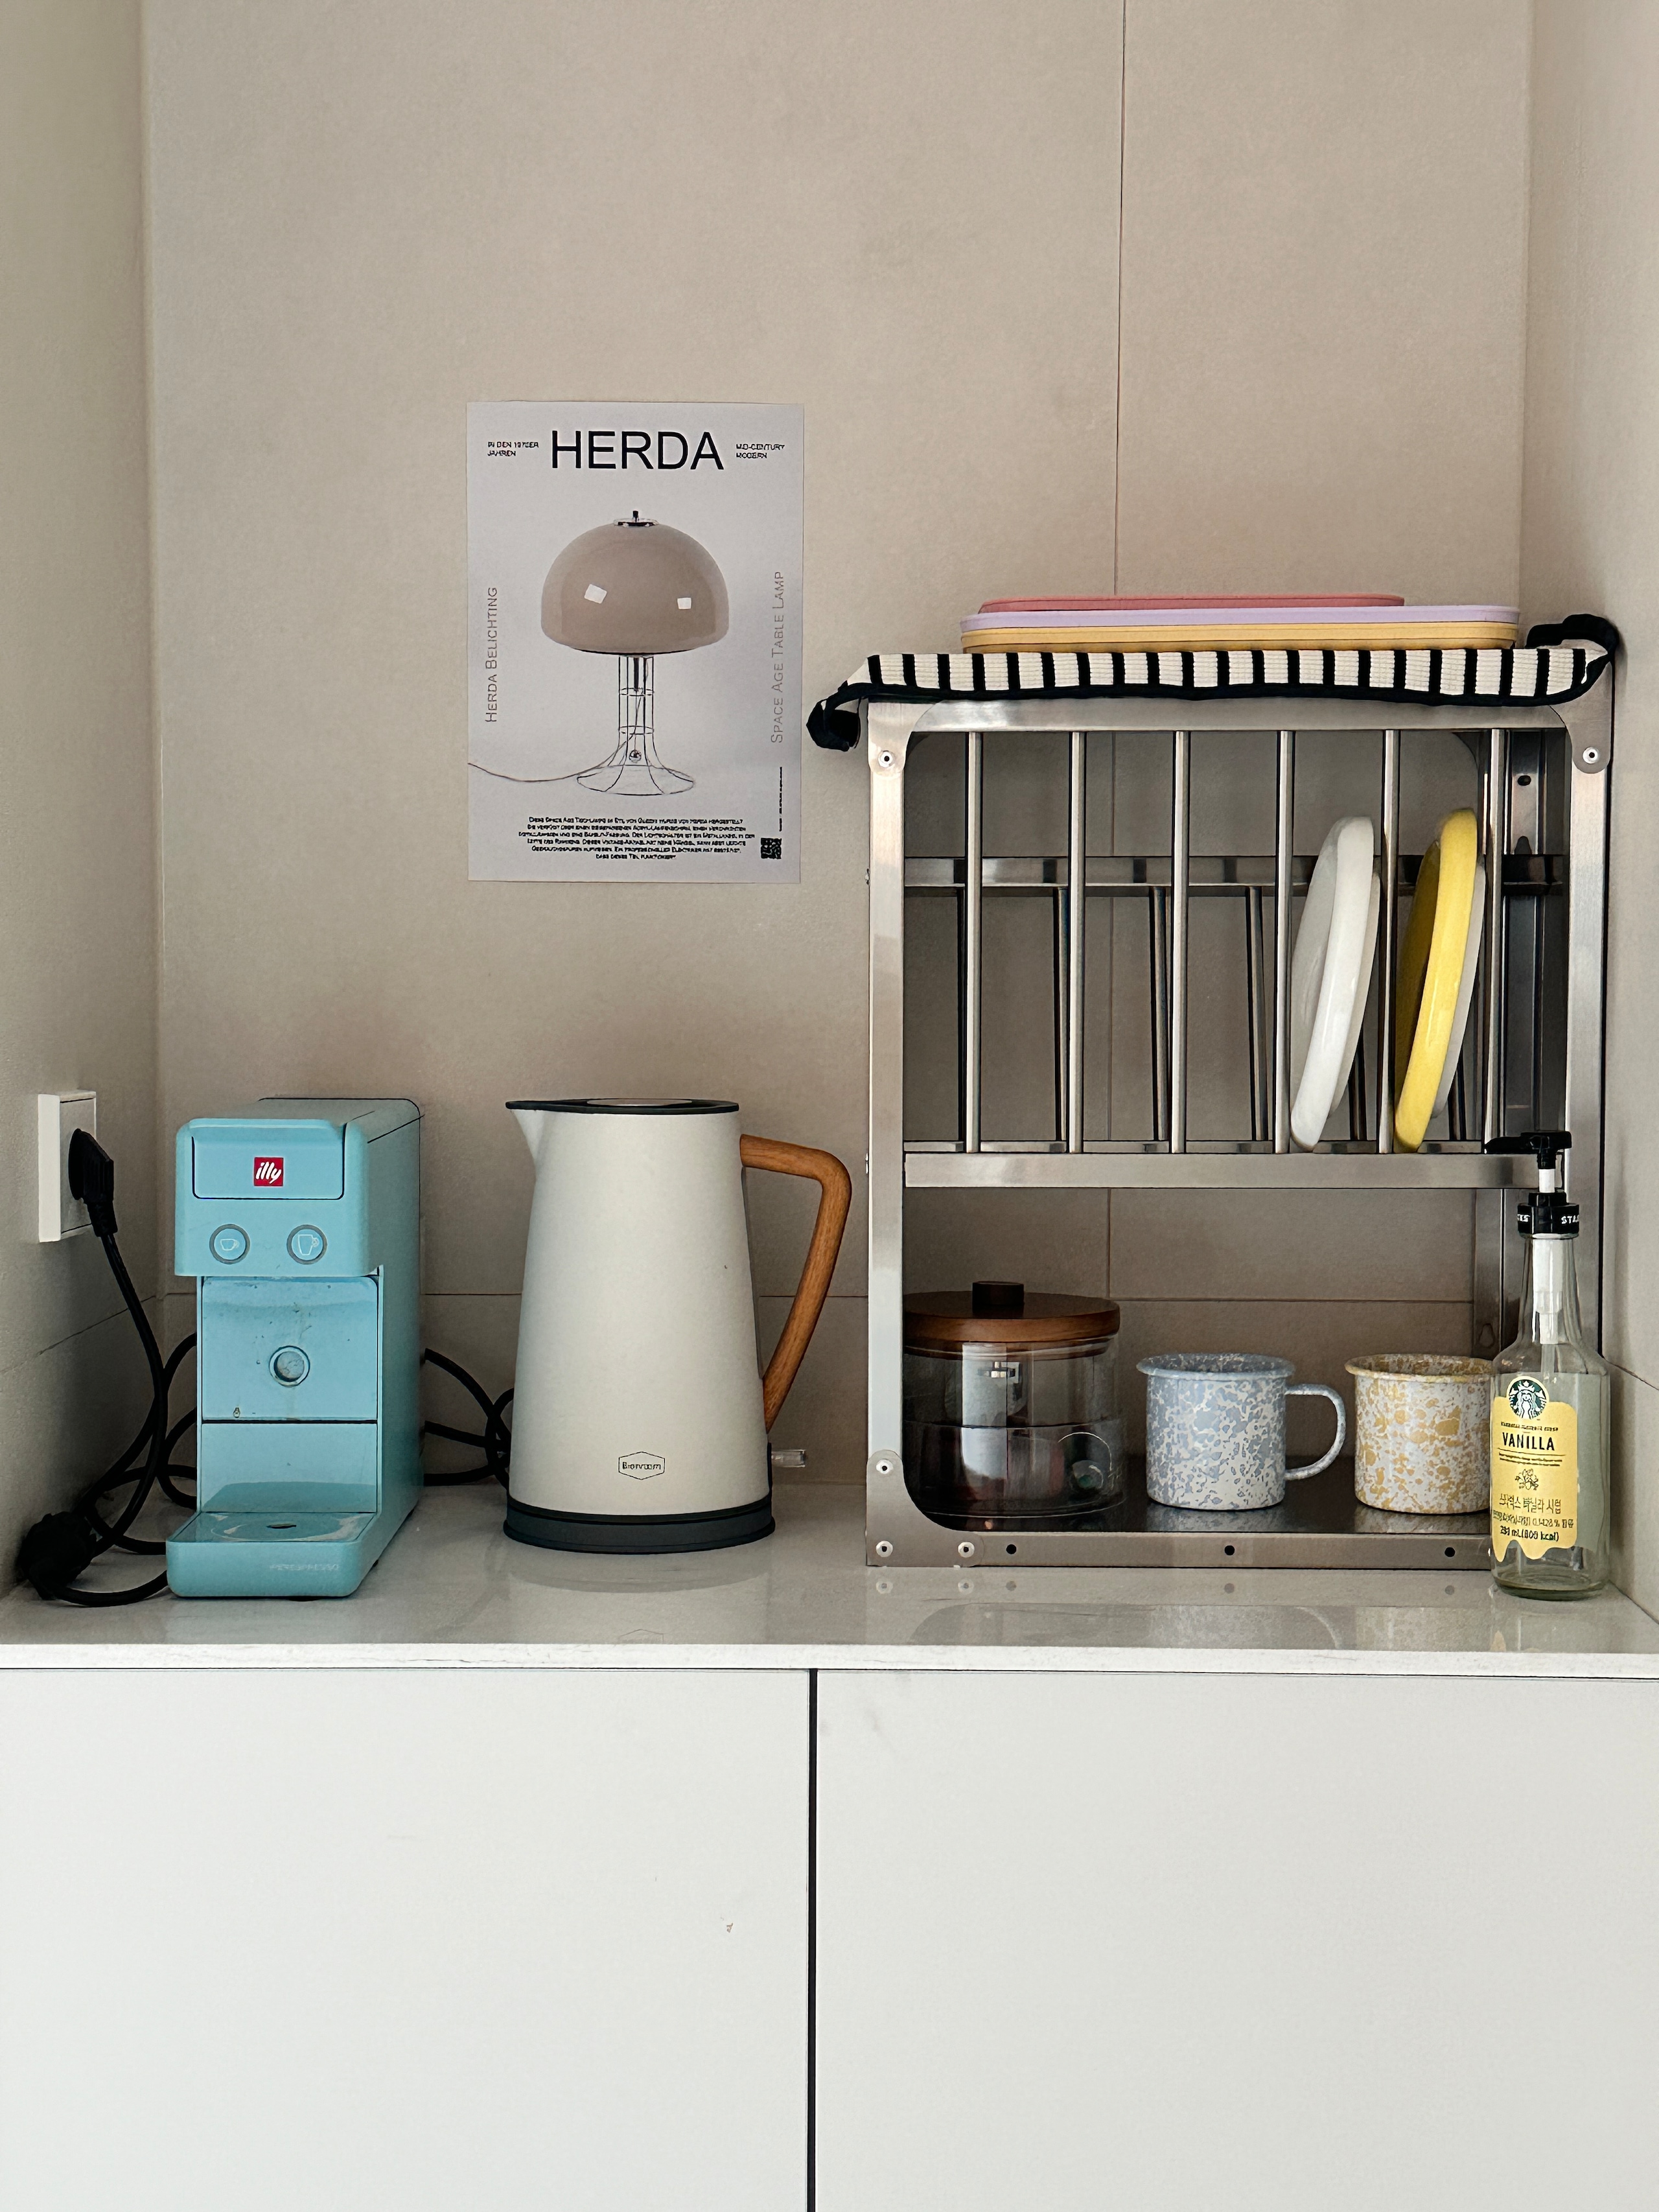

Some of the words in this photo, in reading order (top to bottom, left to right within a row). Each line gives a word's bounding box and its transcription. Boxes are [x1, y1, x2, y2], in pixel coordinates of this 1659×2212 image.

[551, 430, 725, 470] HERDA
[772, 571, 785, 609] LAMP
[485, 587, 498, 669] BELICHTING
[771, 614, 784, 658] TABLE
[771, 662, 783, 693] AGE
[485, 673, 498, 723] HERDA
[771, 697, 783, 743] SPACE
[255, 1161, 282, 1184] illy
[1502, 1432, 1555, 1451] VANILLA
[1546, 1498, 1561, 1515] 시럽
